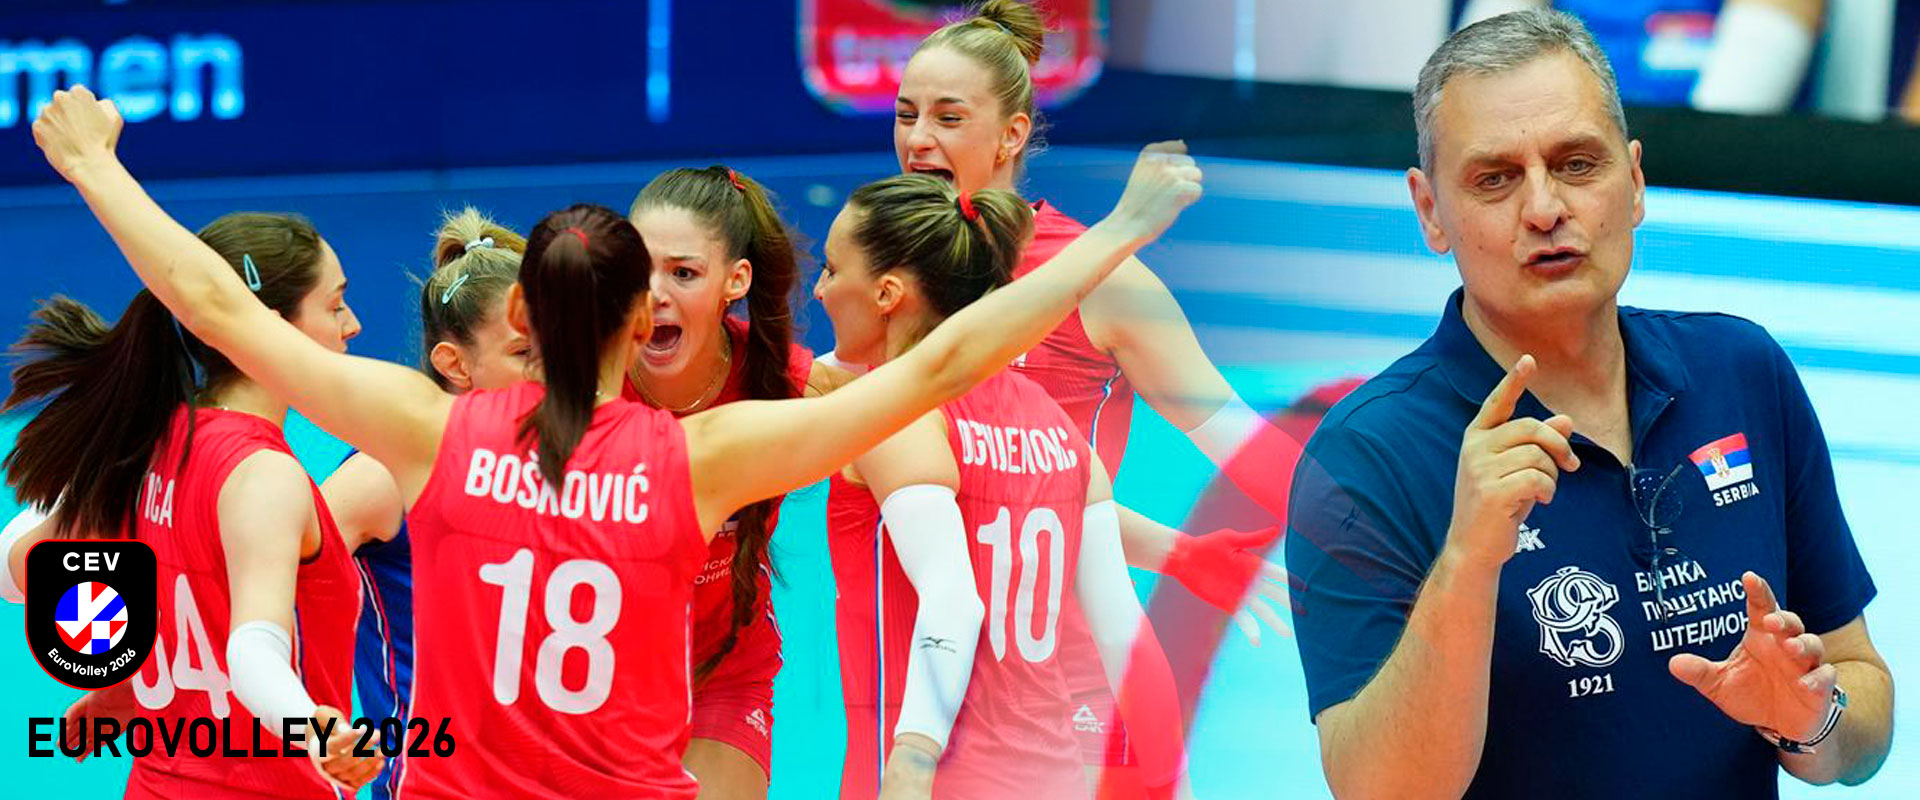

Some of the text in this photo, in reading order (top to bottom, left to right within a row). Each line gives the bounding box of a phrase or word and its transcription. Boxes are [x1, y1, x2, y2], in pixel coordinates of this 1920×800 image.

[1713, 481, 1760, 507] SERBIA
[976, 506, 1066, 663] 10
[478, 547, 623, 715] 18
[1568, 673, 1615, 698] 1921
